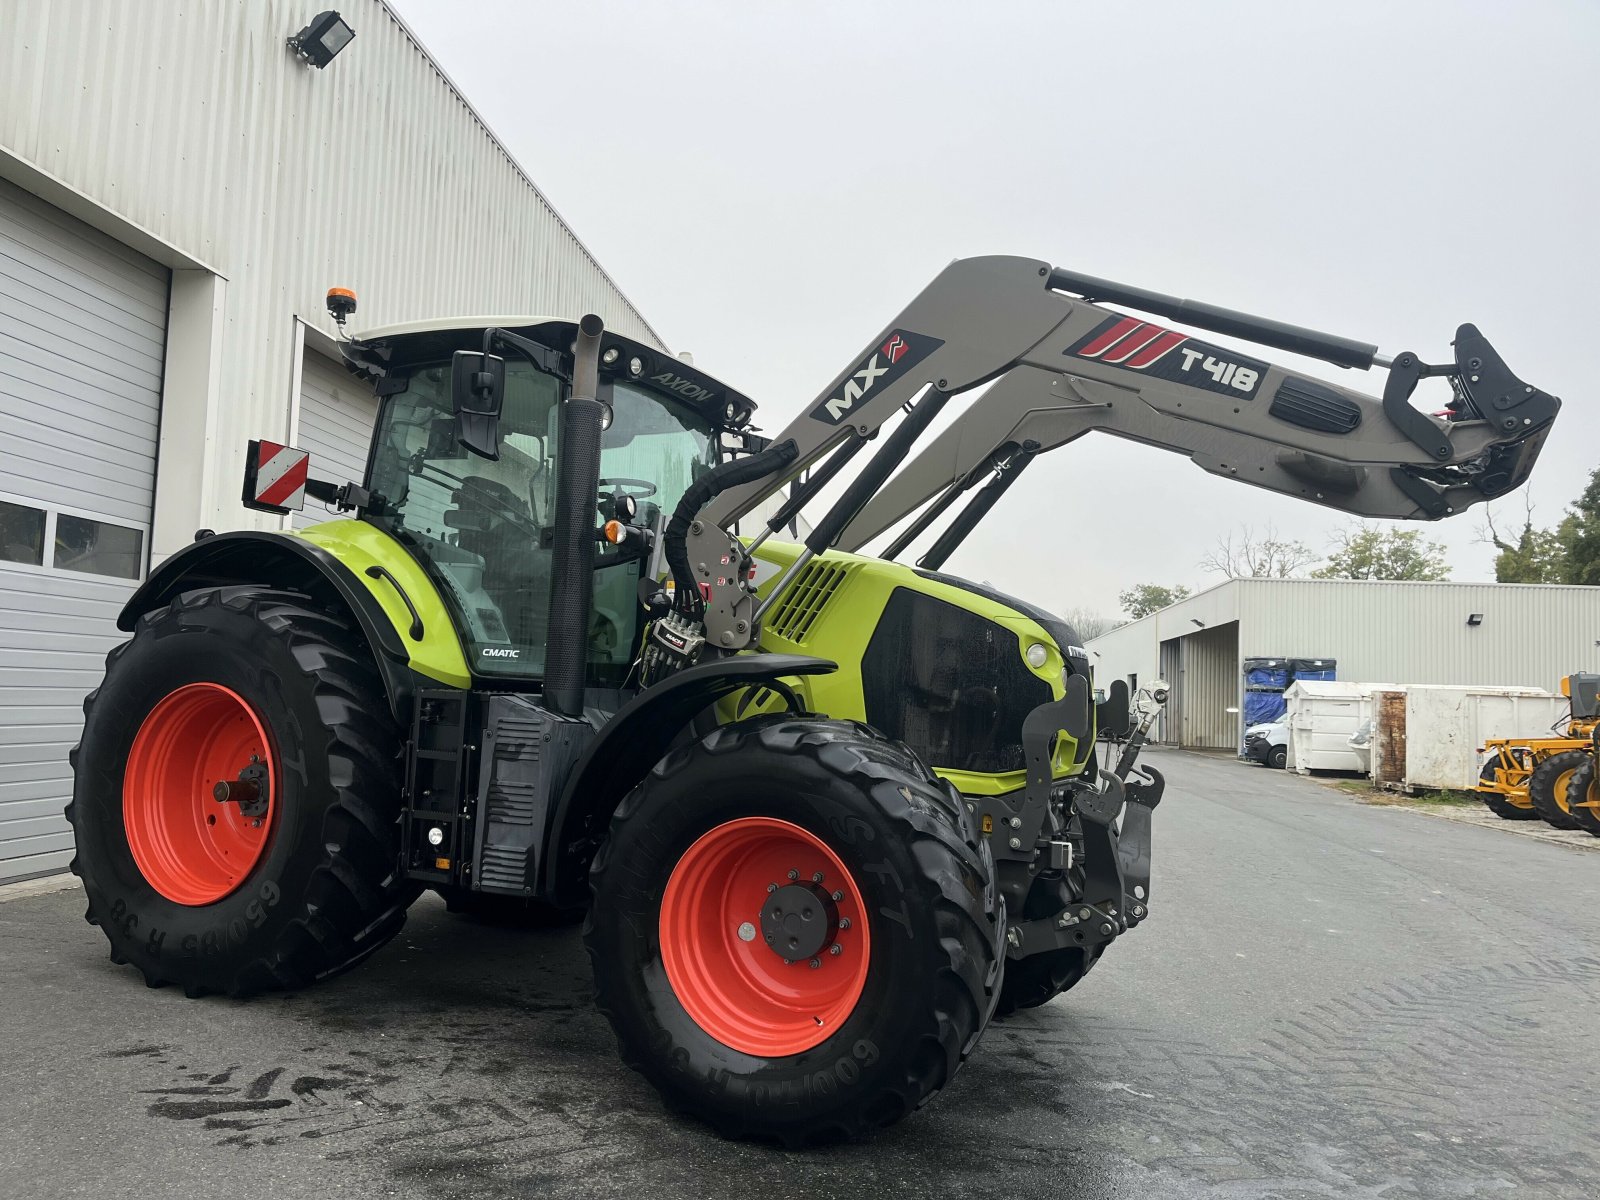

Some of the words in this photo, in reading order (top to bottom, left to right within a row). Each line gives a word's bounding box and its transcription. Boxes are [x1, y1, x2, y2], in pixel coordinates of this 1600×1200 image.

[649, 372, 715, 401] AXION
[825, 353, 889, 420] MX
[482, 648, 520, 658] CMATIC
